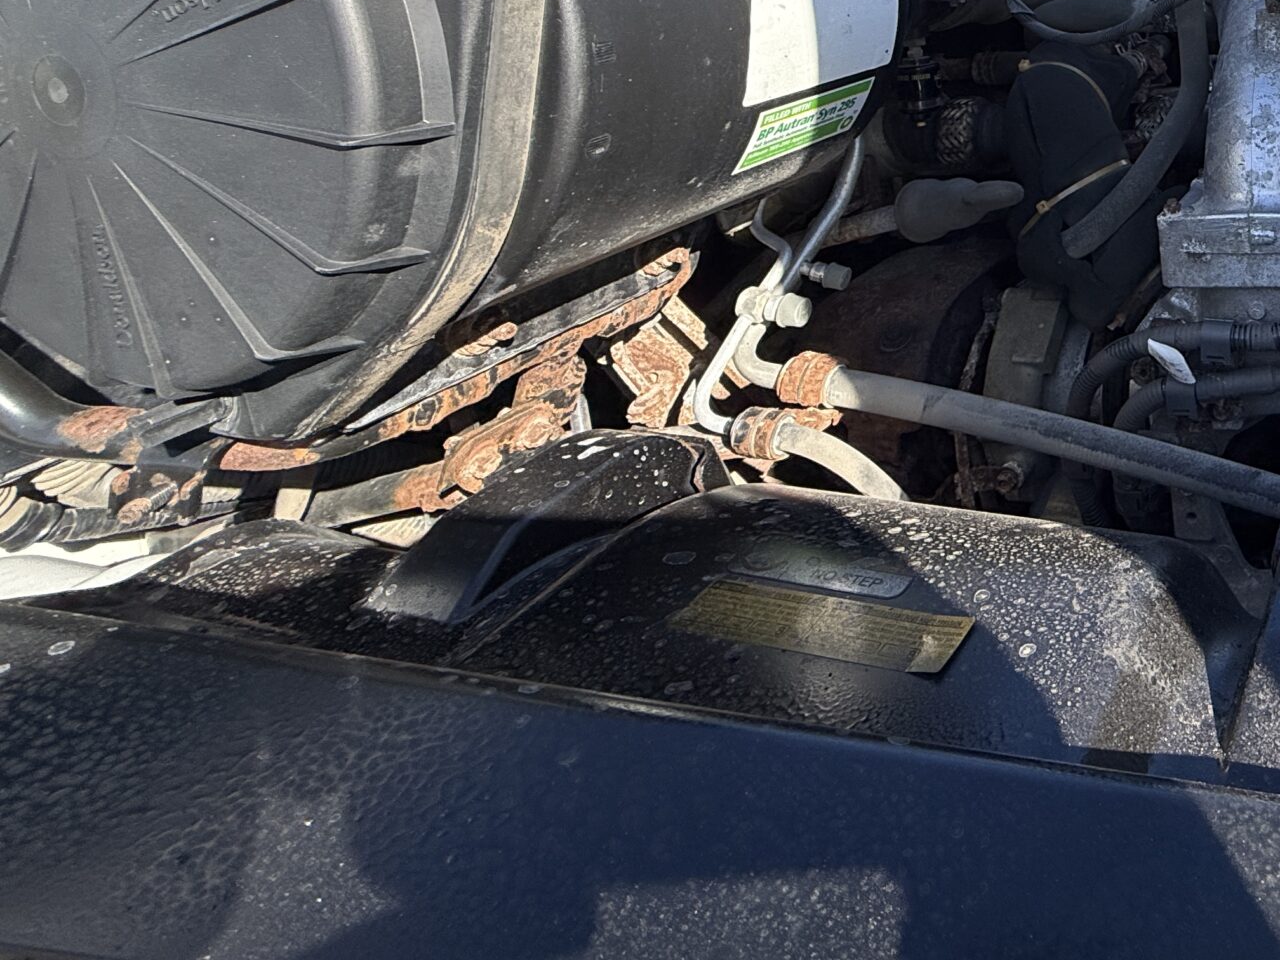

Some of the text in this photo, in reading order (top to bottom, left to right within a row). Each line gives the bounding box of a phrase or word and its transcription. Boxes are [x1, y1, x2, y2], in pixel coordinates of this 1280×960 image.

[757, 126, 775, 141] BP
[773, 113, 815, 136] Autran
[816, 105, 838, 121] Syn
[838, 96, 857, 112] 295
[91, 223, 134, 349] Donaldson
[810, 567, 884, 588] NO STEP
